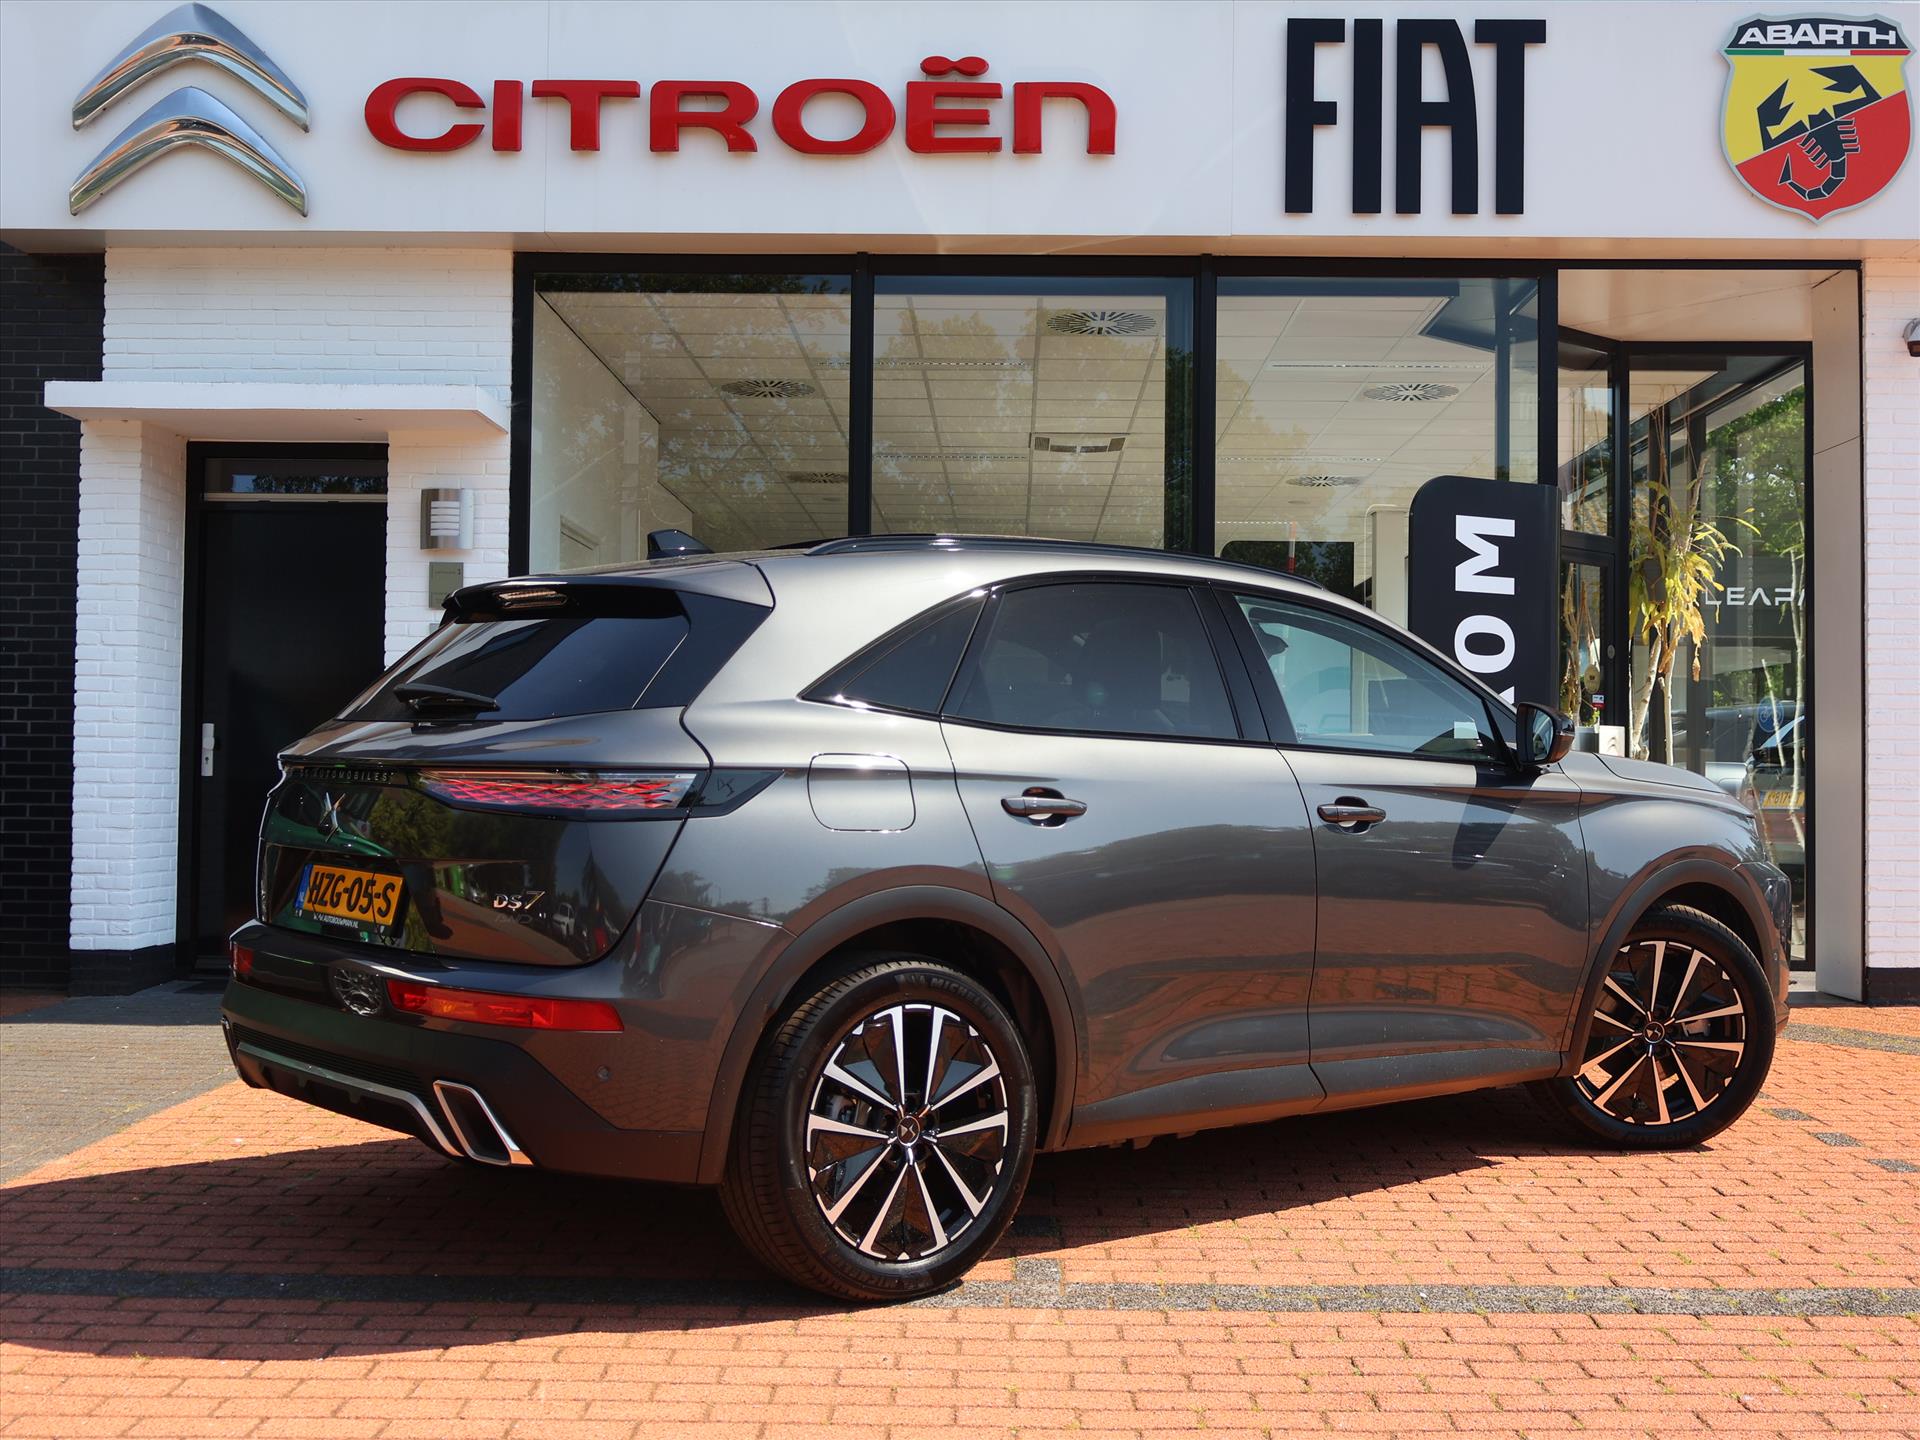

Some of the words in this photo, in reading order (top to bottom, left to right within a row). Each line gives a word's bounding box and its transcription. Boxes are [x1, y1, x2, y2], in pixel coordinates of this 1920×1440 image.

[1738, 23, 1896, 46] ABARTH
[364, 55, 1117, 155] CITROËN
[1284, 18, 1547, 215] FIAT
[1454, 514, 1516, 705] OM
[306, 871, 396, 918] HZG-05-S
